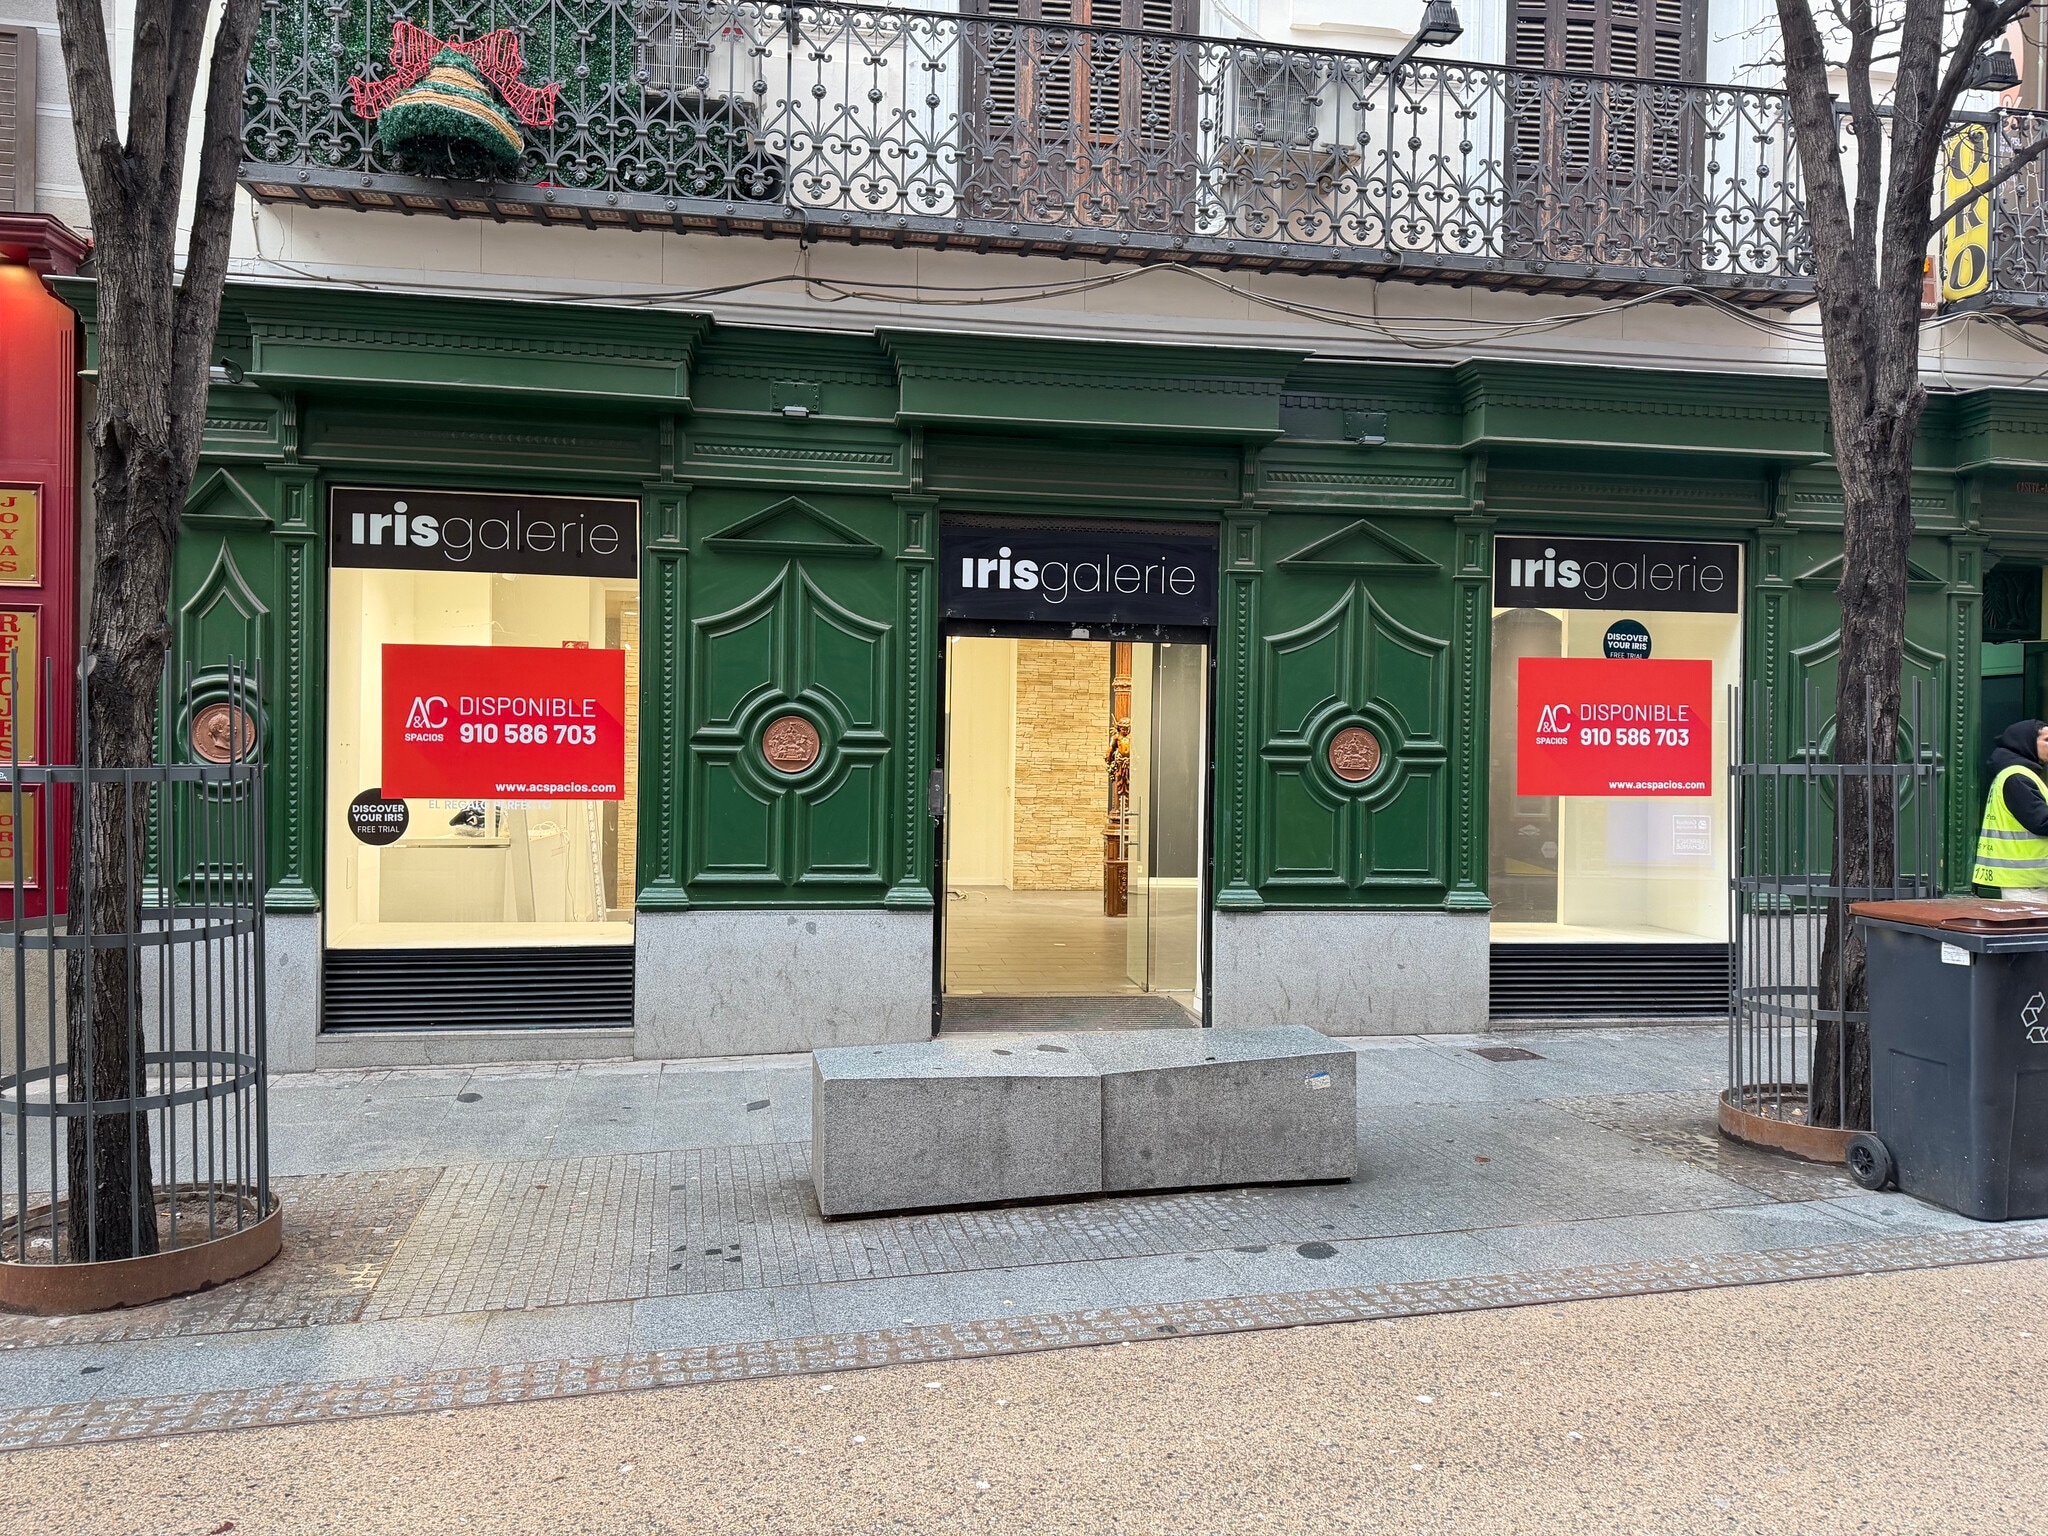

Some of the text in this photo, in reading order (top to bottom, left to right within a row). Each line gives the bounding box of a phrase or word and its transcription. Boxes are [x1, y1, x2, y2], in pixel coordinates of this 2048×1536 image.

[0, 496, 19, 573] JOYAS
[1607, 633, 1649, 643] DISCOVER
[1607, 641, 1647, 650] YOUR IRIS
[1610, 651, 1643, 660] FREE TRIAL
[459, 696, 596, 718] DISPONIBLE
[1580, 704, 1690, 722] DISPONIBLE
[404, 733, 444, 742] SPACIOS
[460, 723, 597, 745] 910 586 703
[1580, 727, 1690, 746] 910 586 703
[1535, 737, 1568, 745] SPACIOS
[495, 781, 617, 795] www.acspacios.com
[1608, 780, 1705, 792] www.acspacios.com
[352, 804, 405, 813] DISCOVER
[428, 799, 440, 809] EL
[353, 813, 404, 822] YOUR IRIS
[357, 825, 400, 833] FREE TRIAL
[0, 814, 13, 858] ORO
